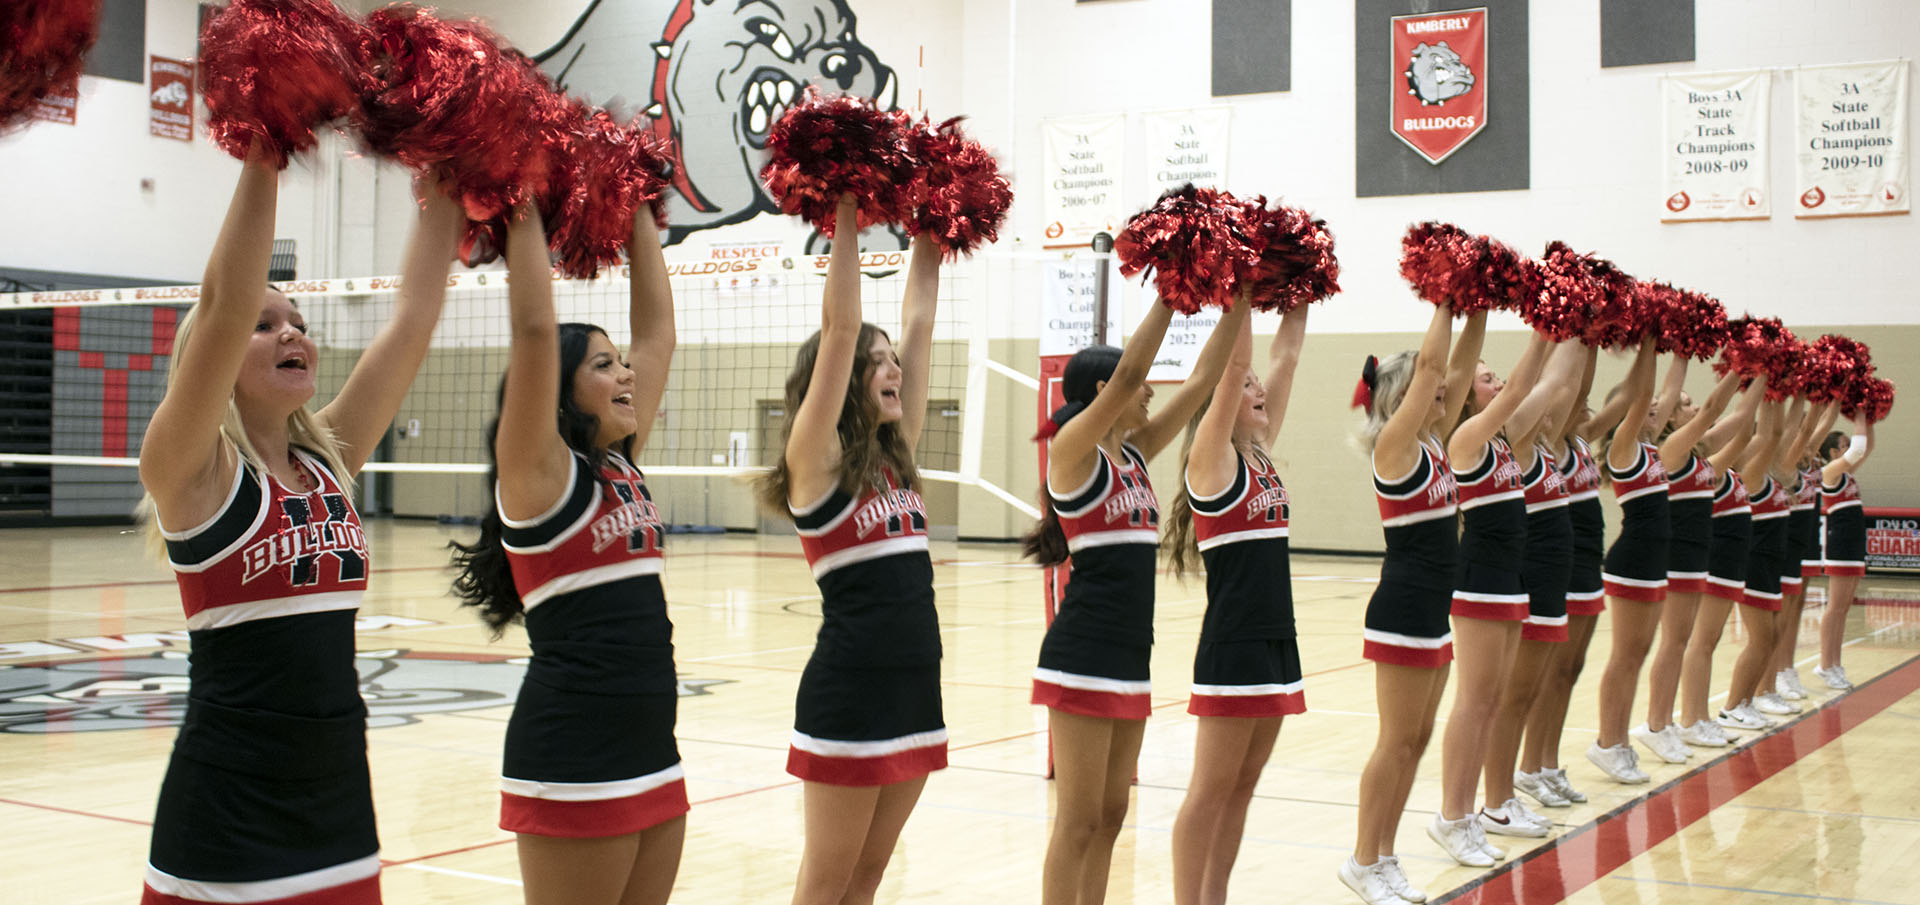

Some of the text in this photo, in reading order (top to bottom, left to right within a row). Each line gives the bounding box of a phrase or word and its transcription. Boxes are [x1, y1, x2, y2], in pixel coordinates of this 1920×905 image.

[1407, 17, 1470, 33] KIMBERLY
[1840, 83, 1860, 96] 3A
[1688, 90, 1742, 105] Boys 3A
[1698, 107, 1732, 119] State
[1832, 101, 1869, 113] State
[1180, 124, 1195, 135] 3A
[1403, 116, 1475, 131] BULLDOGS
[1821, 117, 1880, 132] Softball
[1695, 124, 1735, 137] Track
[1075, 134, 1090, 145] 3A
[1174, 139, 1200, 150] State
[1810, 135, 1893, 150] Champions
[1676, 141, 1755, 155] Champions
[1069, 150, 1096, 161] State
[1166, 154, 1209, 167] Softball
[1821, 154, 1883, 170] 2009-10
[1061, 163, 1104, 176] Softball
[1685, 159, 1749, 174] 2008-09
[1157, 170, 1217, 183] Champions
[1053, 178, 1113, 190] Champions
[1061, 194, 1107, 208] 2006-07
[711, 246, 781, 258] RESPECT
[668, 259, 761, 276] ULLDOGS
[32, 291, 102, 303] BULLDOGS
[1169, 332, 1197, 345] 2022
